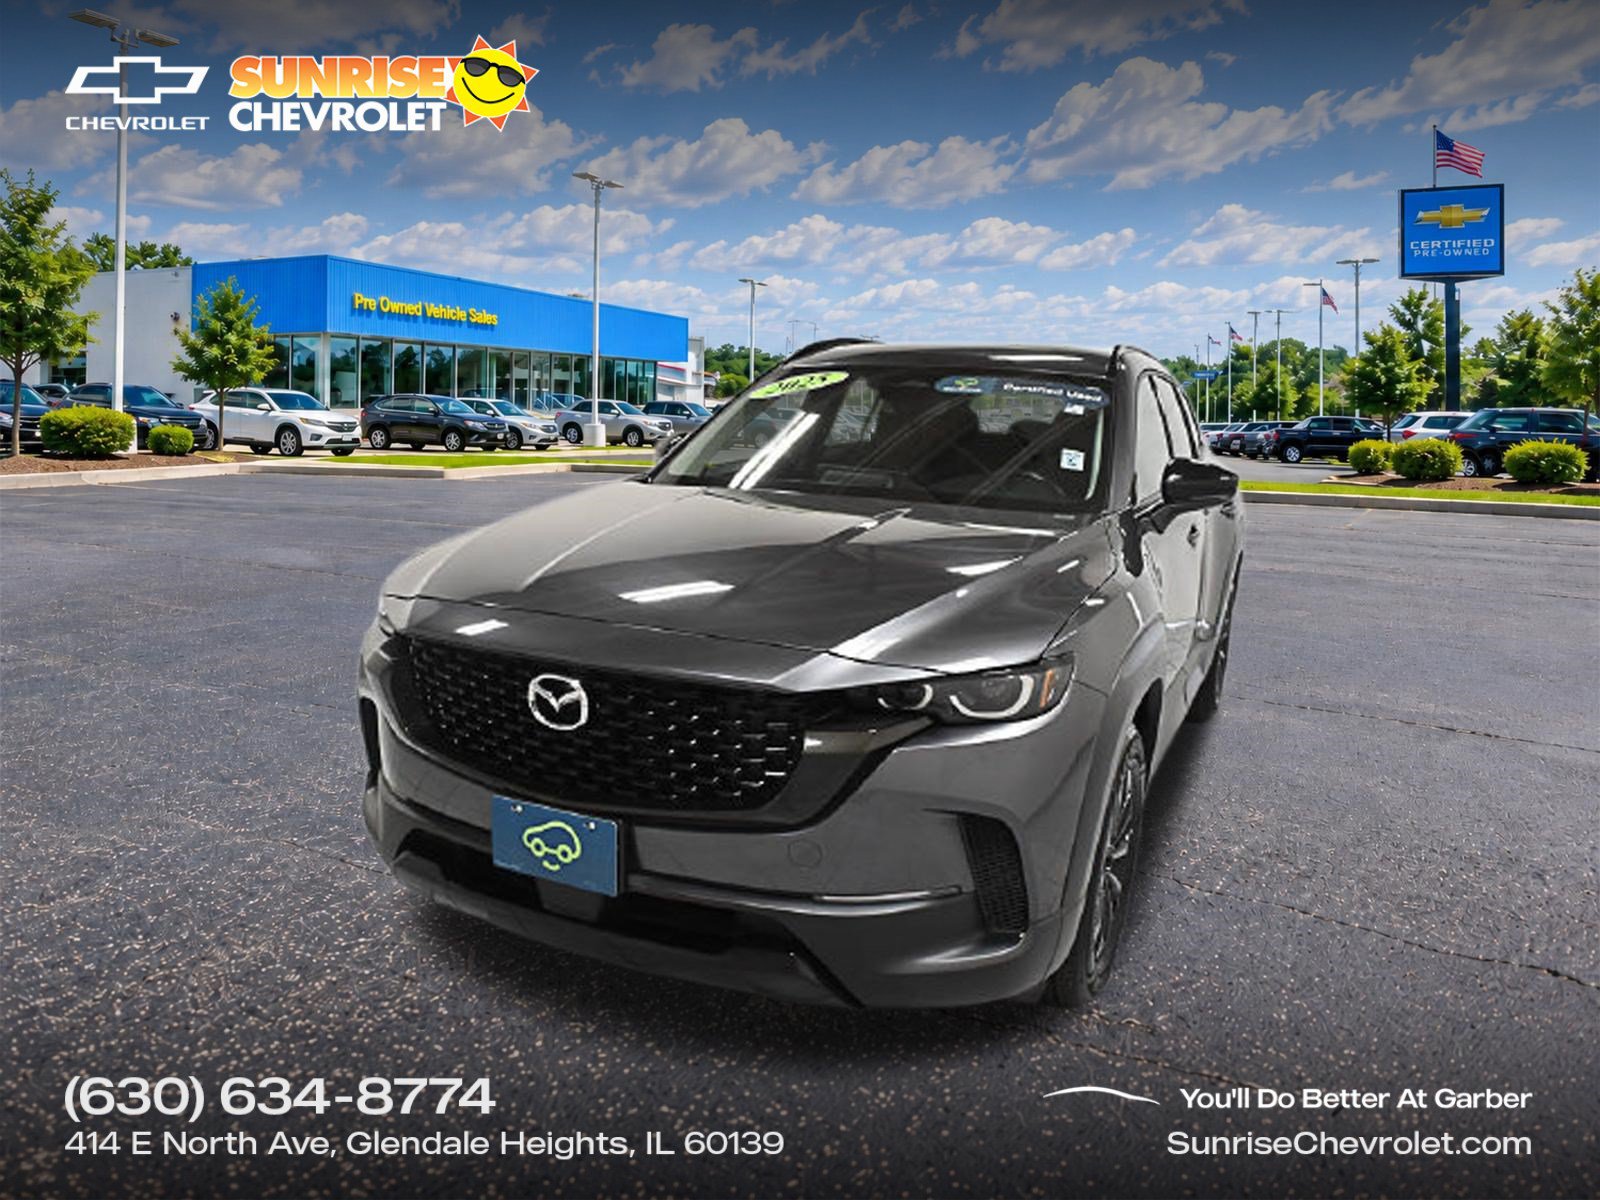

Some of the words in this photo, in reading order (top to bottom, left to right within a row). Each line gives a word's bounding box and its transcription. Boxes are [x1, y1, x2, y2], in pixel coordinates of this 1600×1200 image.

[1410, 238, 1495, 250] CERTIFIED
[1413, 248, 1490, 257] PRE-OWNED
[353, 292, 376, 310] Pre
[379, 296, 422, 316] Owned
[424, 302, 467, 321] Vehicle
[468, 308, 498, 325] Sales
